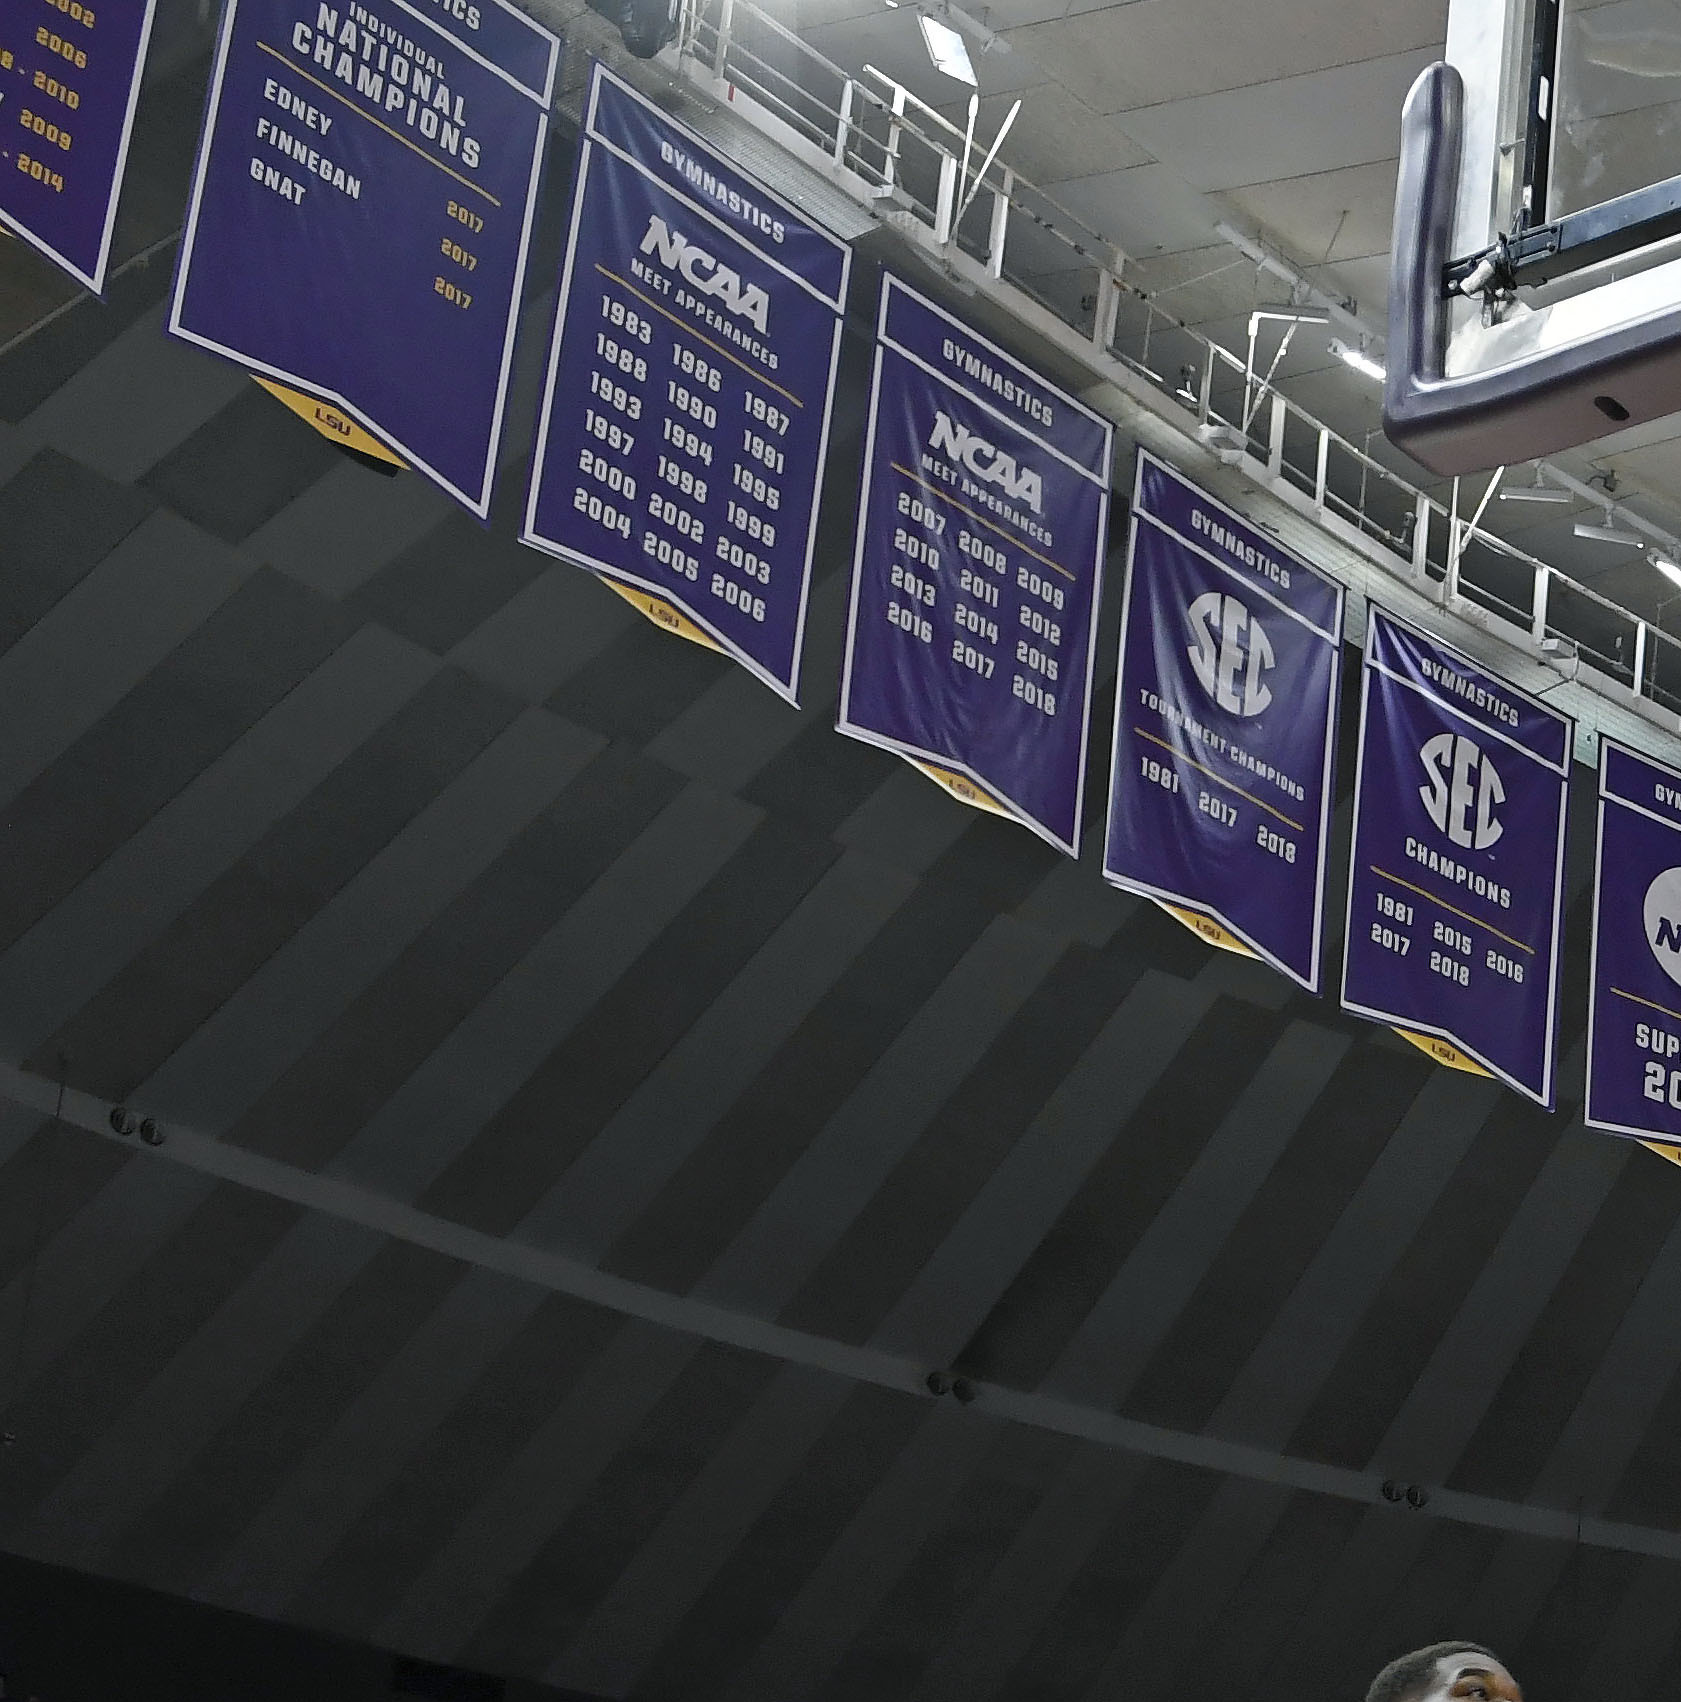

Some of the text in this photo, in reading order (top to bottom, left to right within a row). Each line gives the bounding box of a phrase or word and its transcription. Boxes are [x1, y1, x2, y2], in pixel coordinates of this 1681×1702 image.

[33, 70, 80, 111] 2010
[36, 26, 87, 69] 2006
[292, 22, 481, 168] CHAMPIONS
[316, 2, 466, 127] NATIONAL
[349, 4, 445, 79] INDIVIDUAL
[17, 153, 64, 193] 2014
[20, 109, 73, 151] 2009
[263, 78, 484, 233] EDNEY 2017
[250, 157, 473, 310] GNAT 2017
[256, 118, 478, 271] FINNEGAN 2017
[661, 141, 785, 244] GYMNASTICS
[630, 257, 779, 370] MEET APPEARANCES
[639, 214, 770, 336] NCAA
[597, 333, 785, 475] 1988 1990 1991
[602, 295, 790, 436] 1983 1986 1987
[943, 338, 1053, 427] GYMNASTICS
[313, 406, 351, 436] LSU
[591, 371, 780, 511] 1993 1994 1995
[928, 410, 1043, 516] NCAA
[578, 448, 771, 585] 2000 2002 2003
[585, 408, 776, 548] 1997 1998 1999
[922, 453, 1053, 548] MEET APPEARANCES
[573, 487, 766, 622] 2004 2005 2006
[1191, 509, 1291, 590] GYMNASTICS
[890, 564, 999, 645] 2013 2014
[1187, 592, 1276, 717] SEC
[1140, 688, 1304, 801] TOURNAMENT CHAMPIONS
[1421, 657, 1519, 728] GYMNASTICS
[1141, 757, 1296, 864] 1981 2017 2018
[1418, 733, 1506, 850] SEC
[1405, 836, 1511, 909] CHAMPIONS
[1370, 922, 1470, 987] 2017 2018
[1376, 892, 1524, 984] 1981 2015 2016
